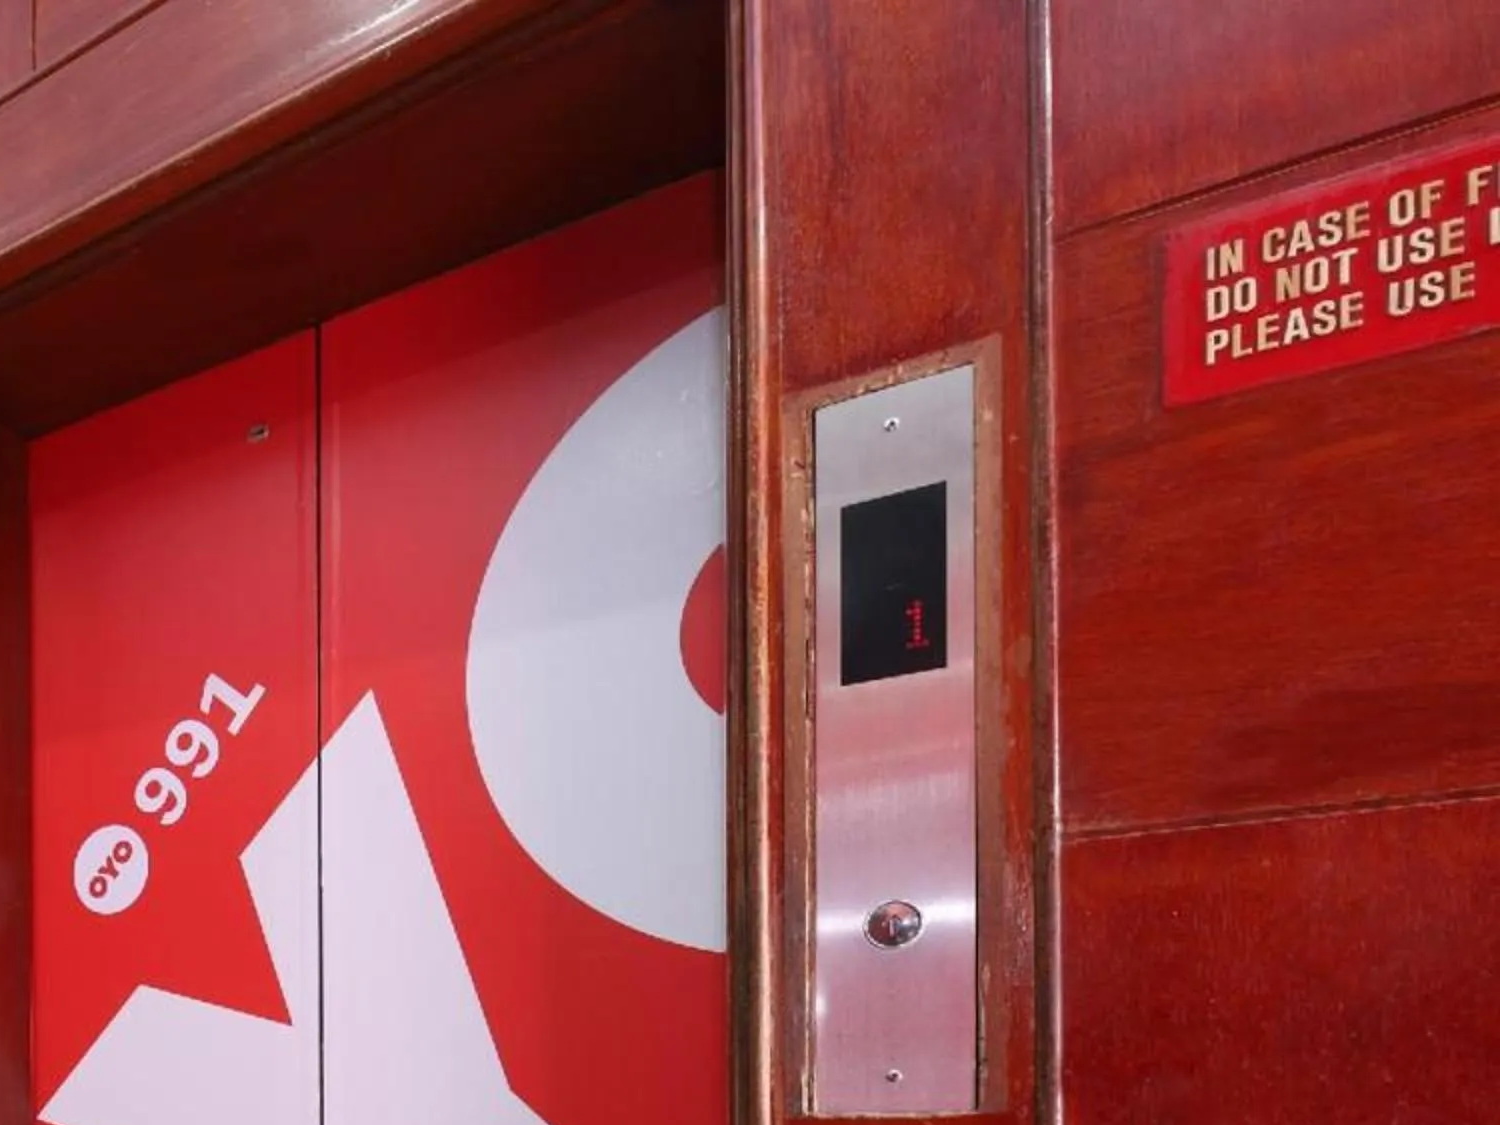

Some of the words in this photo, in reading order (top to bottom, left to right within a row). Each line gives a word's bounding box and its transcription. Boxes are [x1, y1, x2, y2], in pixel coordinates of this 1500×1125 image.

[1205, 239, 1245, 281] IN
[1261, 201, 1370, 263] CASE
[1388, 179, 1445, 227] OF
[1468, 164, 1500, 206] F
[1205, 278, 1257, 322] DO
[1275, 247, 1359, 303] NOT
[1377, 217, 1466, 273] USE
[1205, 291, 1365, 366] PLEASE
[1387, 262, 1476, 316] USE
[904, 600, 930, 648] 1
[89, 840, 133, 898] OYO
[133, 672, 266, 825] 991
